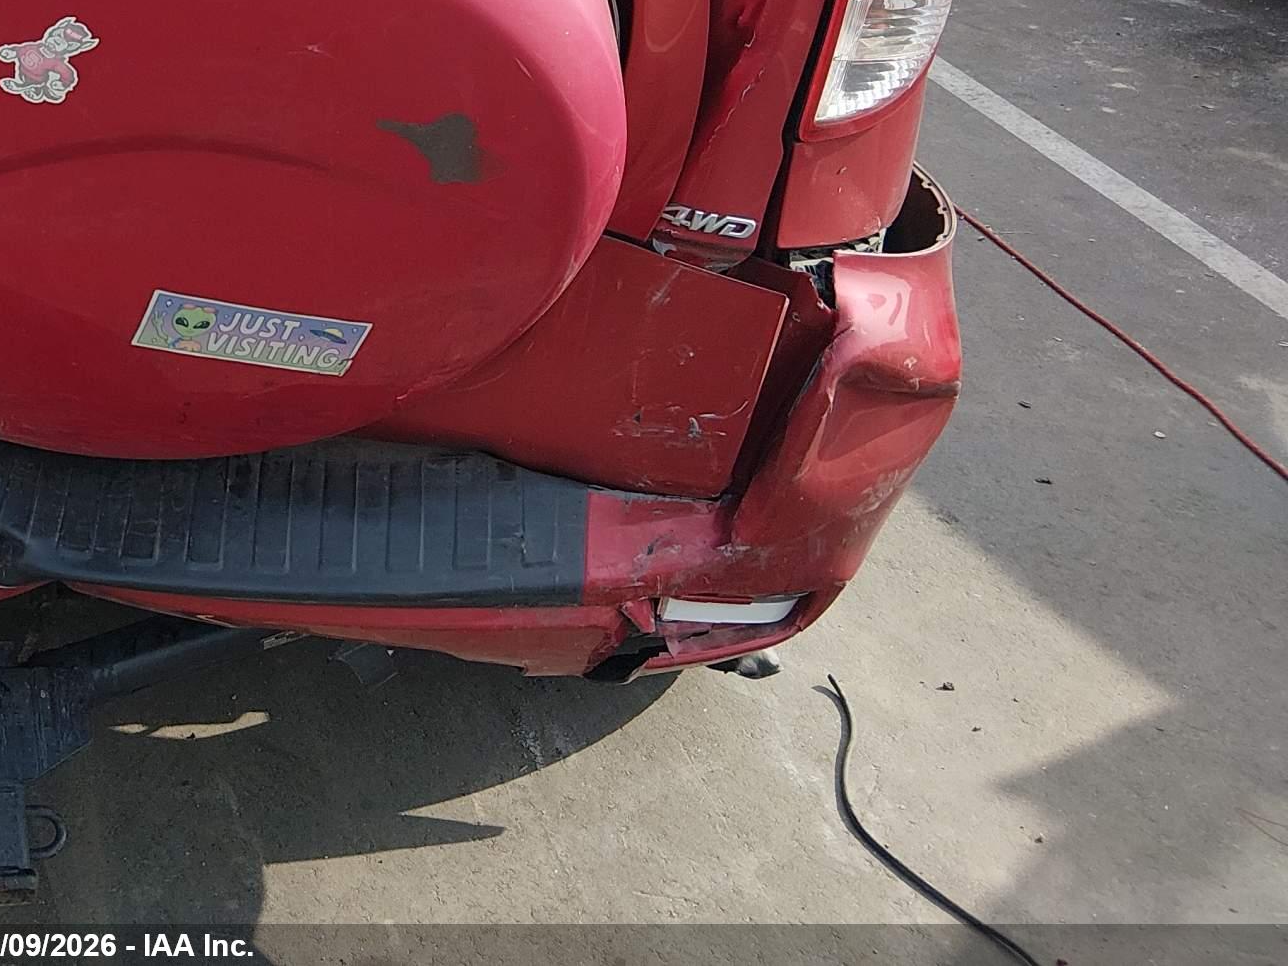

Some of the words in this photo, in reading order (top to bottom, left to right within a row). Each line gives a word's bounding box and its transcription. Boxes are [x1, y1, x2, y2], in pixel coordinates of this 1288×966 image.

[660, 205, 757, 239] 4WD
[218, 312, 302, 341] JUST
[206, 332, 342, 368] VISITING
